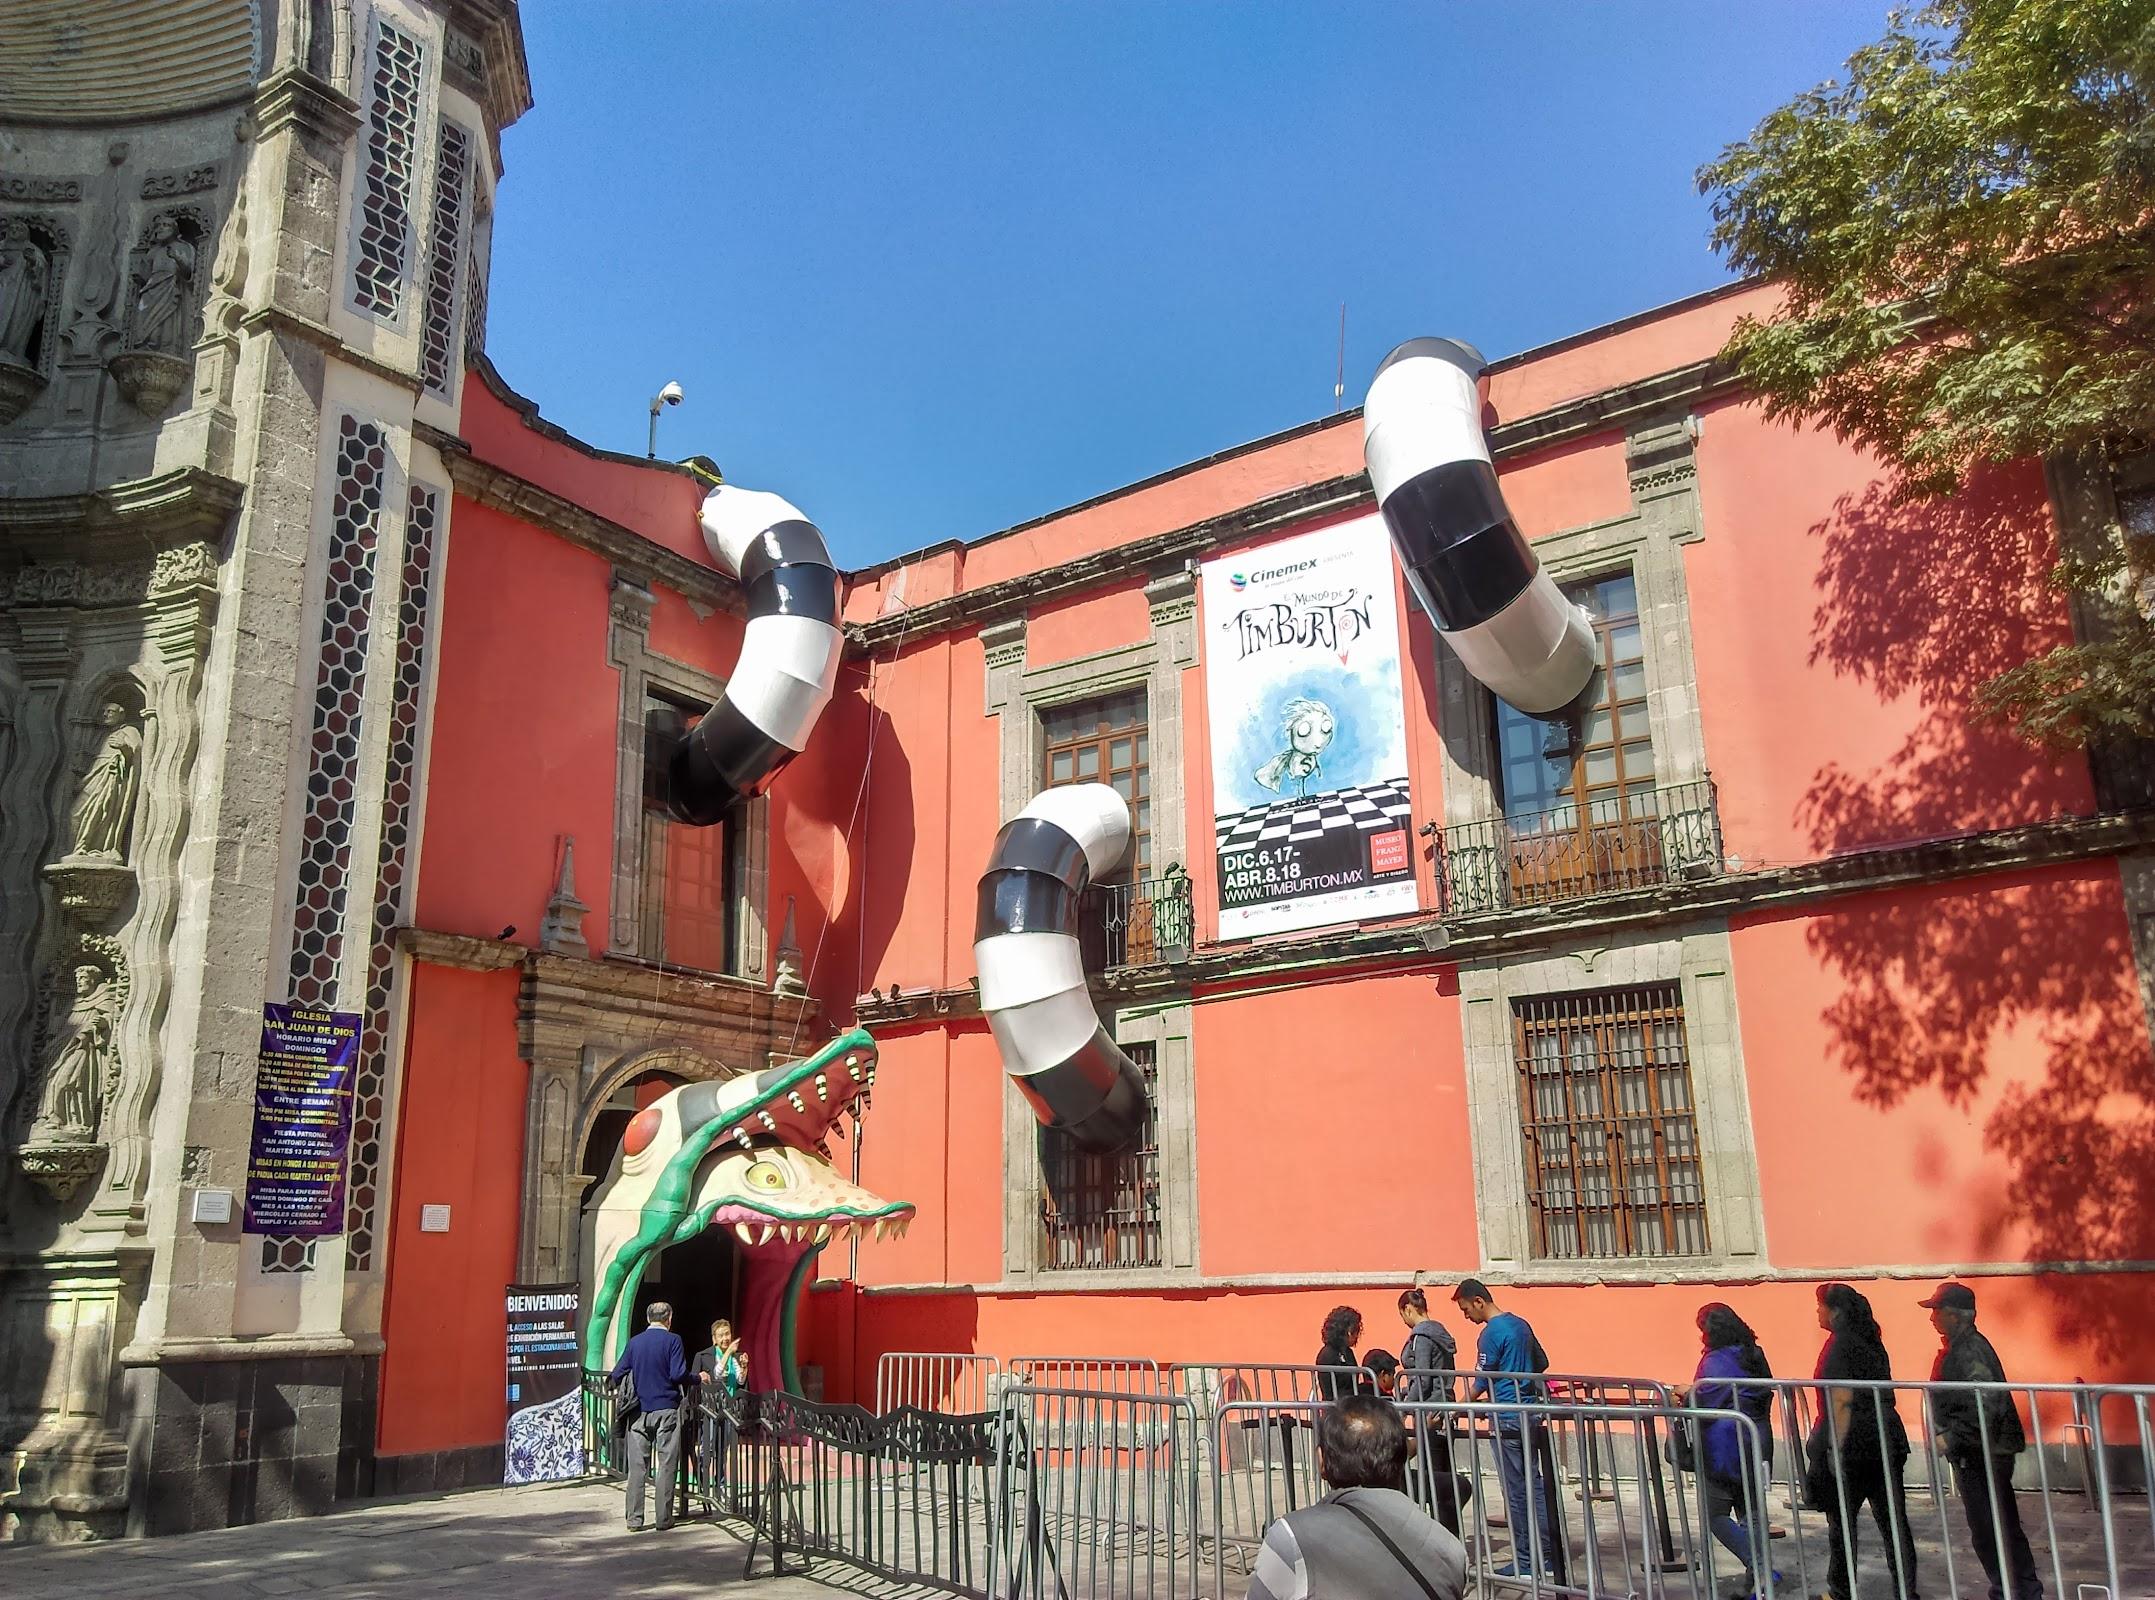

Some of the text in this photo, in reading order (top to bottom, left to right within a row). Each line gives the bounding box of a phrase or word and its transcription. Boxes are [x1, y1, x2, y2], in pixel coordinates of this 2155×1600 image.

[1251, 558, 1317, 583] Cinemex
[1295, 590, 1329, 607] MUNDO
[1376, 835, 1401, 845] MUSEO
[1376, 846, 1401, 856] FRANZ
[1224, 846, 1300, 872] DIC.6.17-
[1377, 856, 1403, 866] MAYER
[1225, 863, 1300, 890] ABR.8.18
[1225, 869, 1363, 903] WWW.TIMBURTON.MX
[292, 1011, 331, 1022] IGLESIA
[264, 1020, 284, 1029] SAN
[287, 1023, 314, 1032] JUAN
[334, 1028, 355, 1036] DIOS
[277, 1034, 311, 1043] HORARIO
[285, 1045, 326, 1054] DOMINGOS
[274, 1096, 334, 1106] ENTRE SEMANA
[256, 1158, 272, 1166] MISAS
[274, 1159, 281, 1167] EN
[283, 1160, 302, 1168] HONOR
[290, 1172, 311, 1180] MARTES
[508, 1294, 578, 1312] BIENVENIDOS
[548, 1321, 564, 1329] SALAS
[543, 1331, 576, 1340] PERMANENTE
